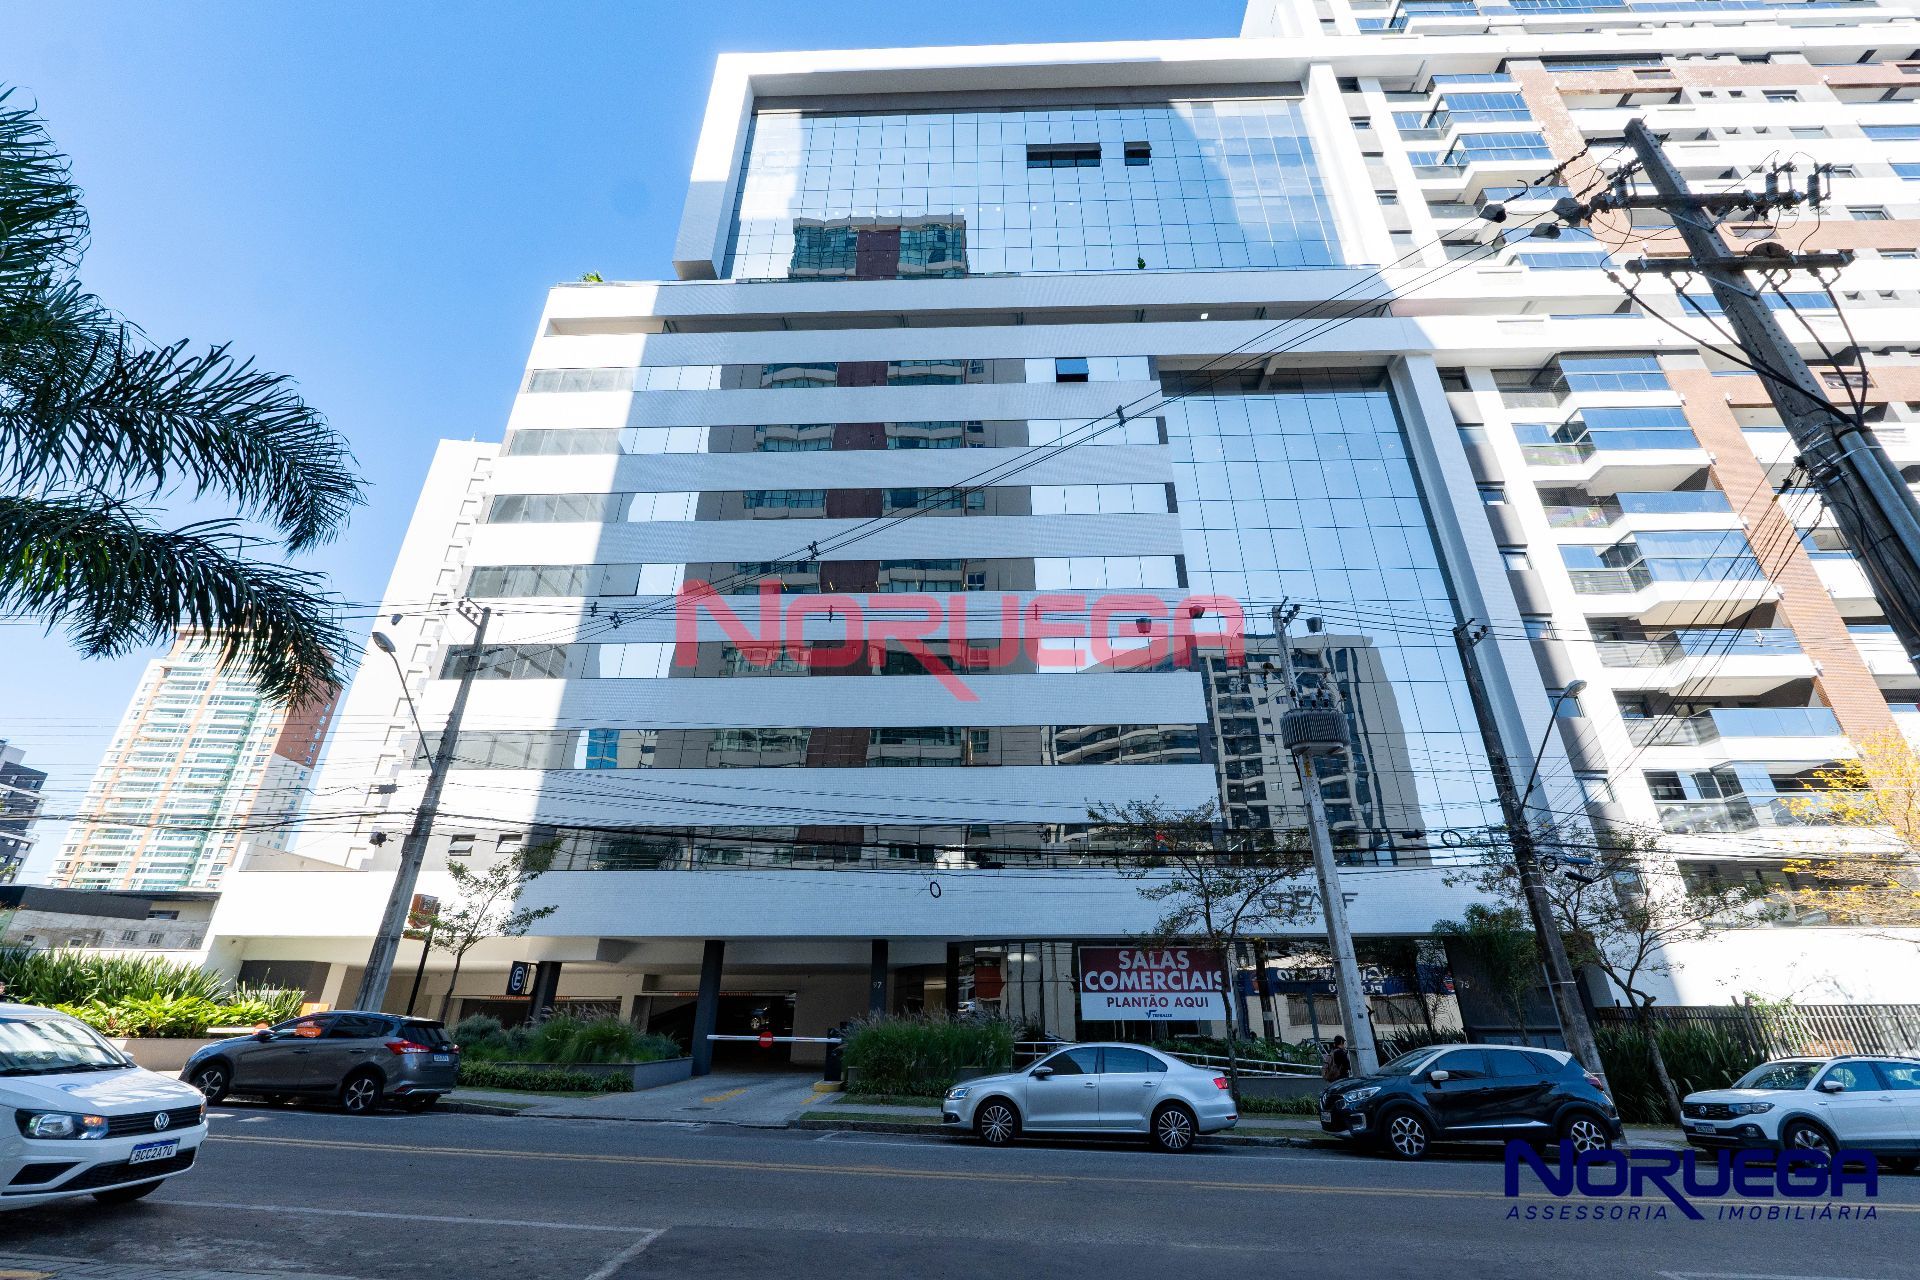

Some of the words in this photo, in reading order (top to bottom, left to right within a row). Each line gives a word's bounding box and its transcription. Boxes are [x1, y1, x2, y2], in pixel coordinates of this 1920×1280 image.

[1118, 950, 1190, 970] SALAS
[1084, 970, 1225, 991] COMERCIAIS
[1106, 994, 1169, 1008] PLANTÃO
[1174, 996, 1209, 1008] AQUI
